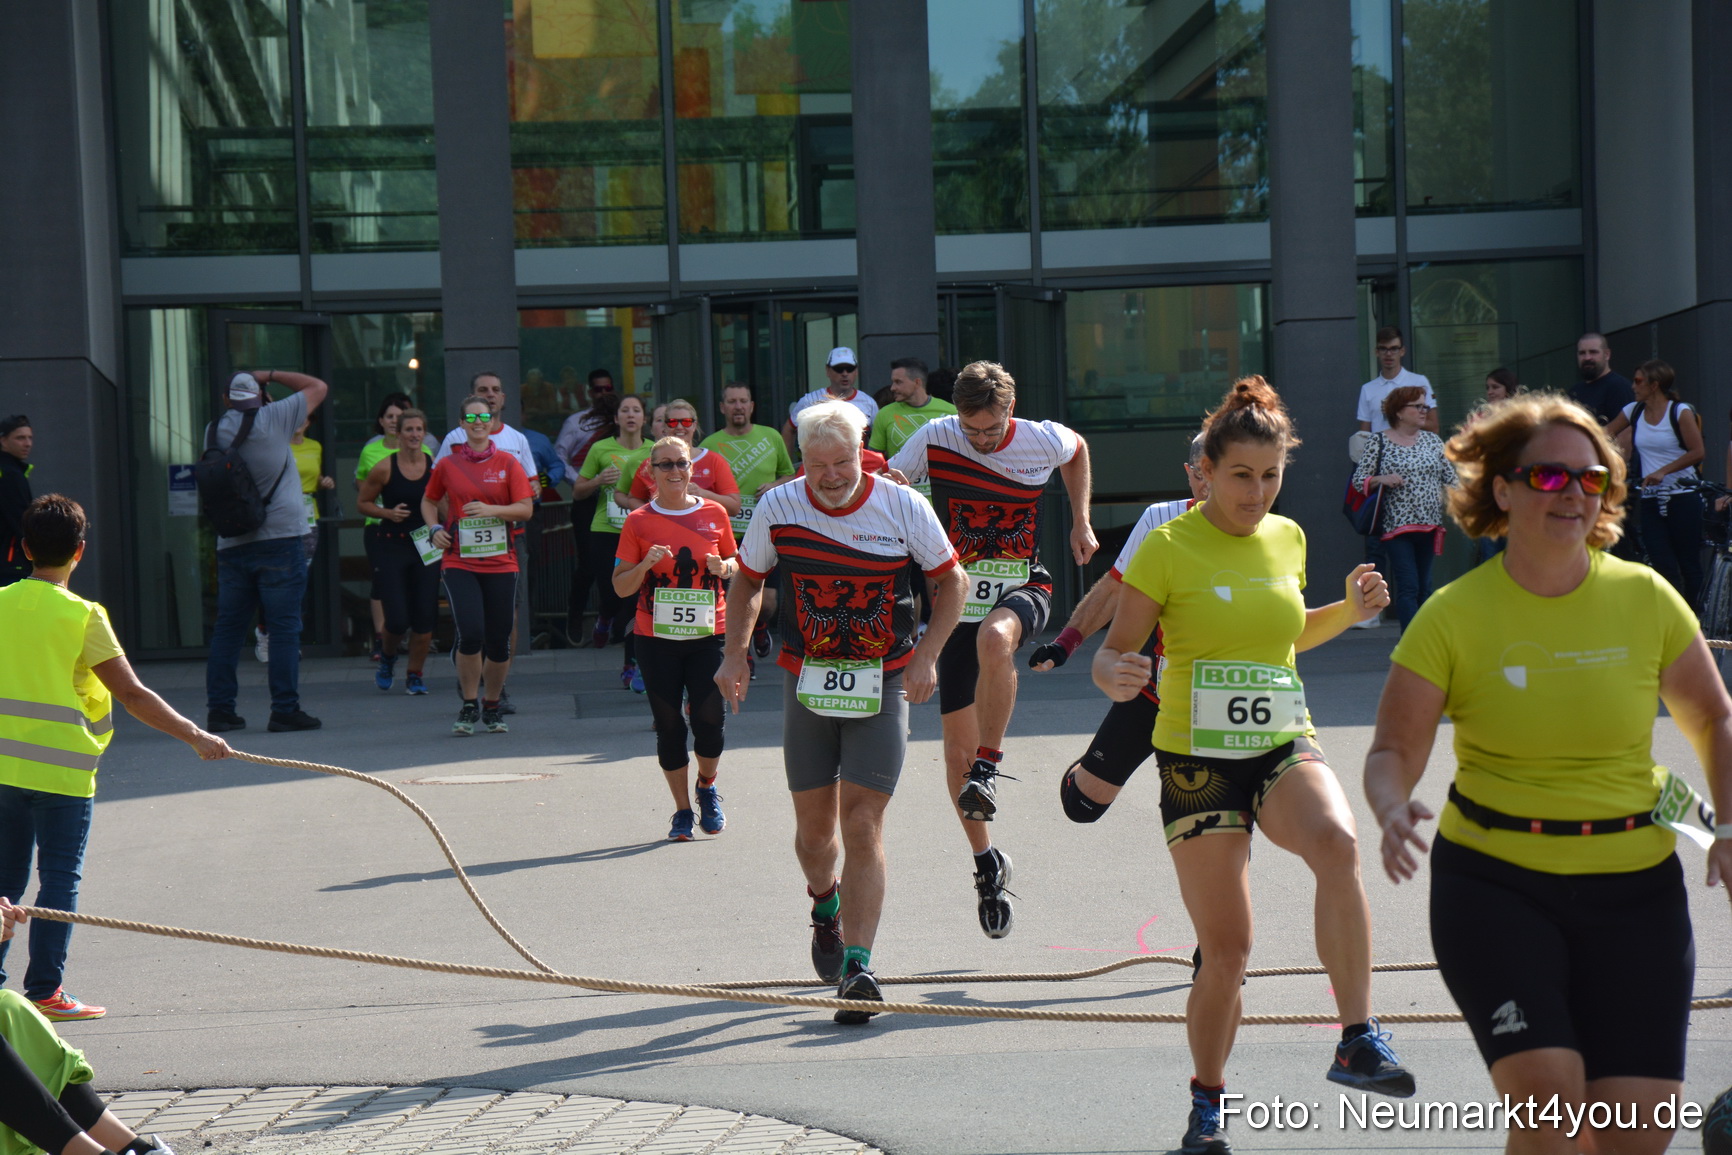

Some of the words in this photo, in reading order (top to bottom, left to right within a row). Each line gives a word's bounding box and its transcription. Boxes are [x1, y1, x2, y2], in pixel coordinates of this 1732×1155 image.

[634, 343, 653, 355] RE
[731, 437, 771, 475] KHARDT
[462, 517, 503, 528] BOCK
[474, 530, 493, 543] 53
[852, 534, 898, 543] NEUMARKT
[471, 545, 498, 553] SABINE
[659, 590, 710, 604] BOCK
[976, 580, 1004, 600] 81
[672, 606, 696, 623] 55
[668, 626, 698, 635] TANJA
[823, 670, 856, 692] 80
[1202, 665, 1295, 689] BOCK
[808, 696, 868, 710] STEPHAN
[1227, 696, 1272, 726] 66
[1223, 734, 1273, 748] ELISA
[1660, 775, 1690, 823] BO
